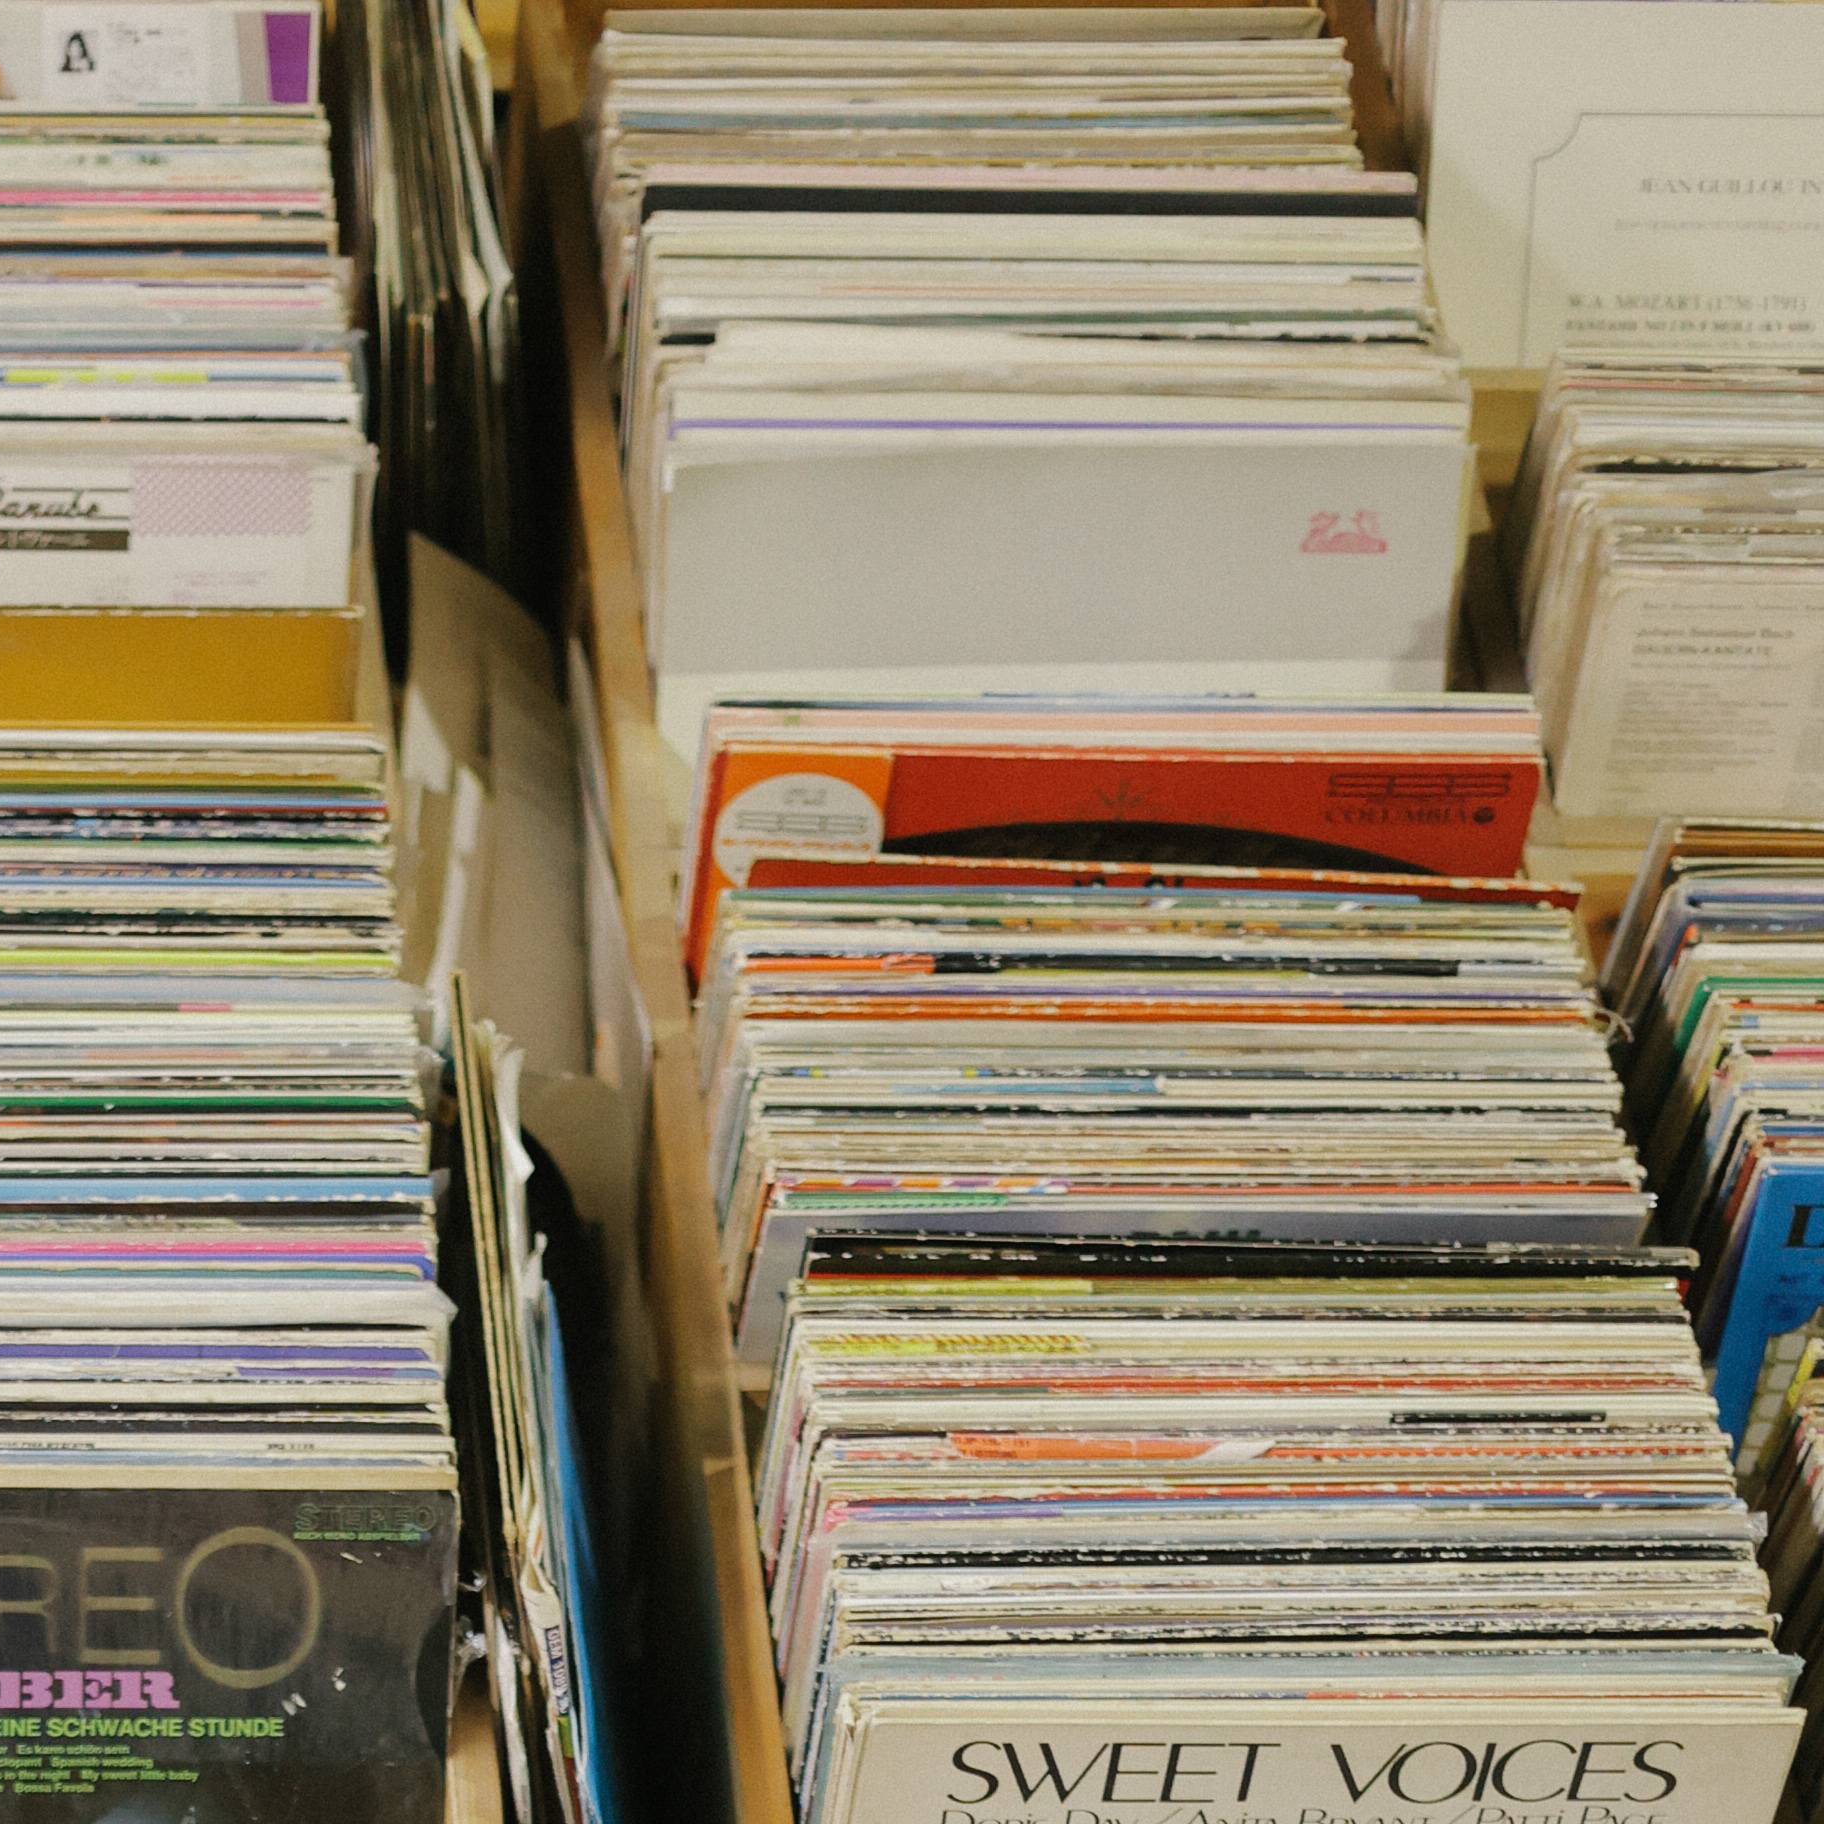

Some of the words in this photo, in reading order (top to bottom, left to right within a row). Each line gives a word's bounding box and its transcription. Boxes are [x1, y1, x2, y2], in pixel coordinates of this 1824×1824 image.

[294, 1502, 437, 1532] STEREO
[46, 1716, 184, 1738] SCHWACHE
[187, 1716, 286, 1738] STUNDE
[81, 1769, 100, 1783] My
[946, 1740, 1282, 1804] SWEET
[1330, 1740, 1685, 1804] VOICES
